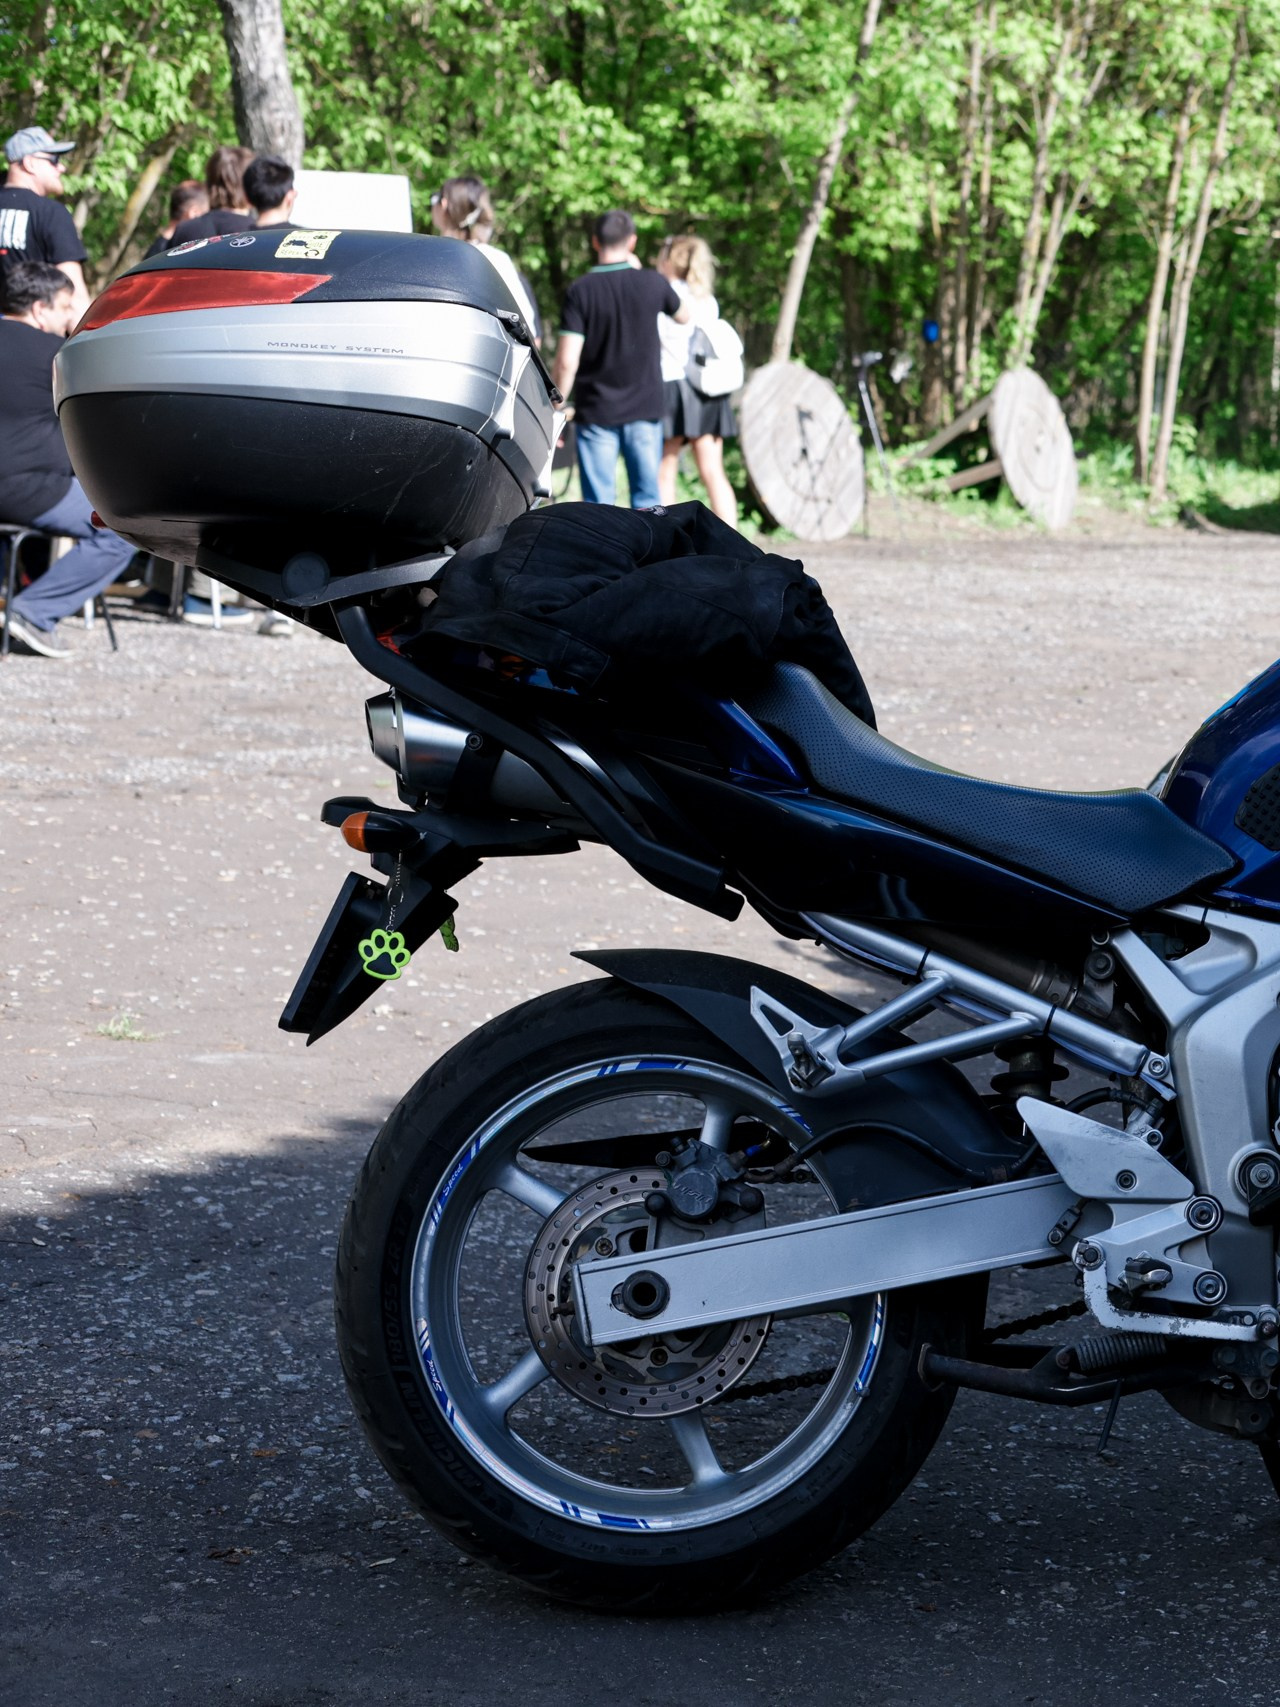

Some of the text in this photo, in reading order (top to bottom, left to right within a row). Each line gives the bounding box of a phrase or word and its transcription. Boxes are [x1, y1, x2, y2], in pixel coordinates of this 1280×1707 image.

[267, 341, 404, 354] MONOKEY SYSTEM
[442, 1162, 464, 1197] Speed
[426, 1359, 442, 1392] Speed
[398, 1378, 482, 1493] MICHELIN
